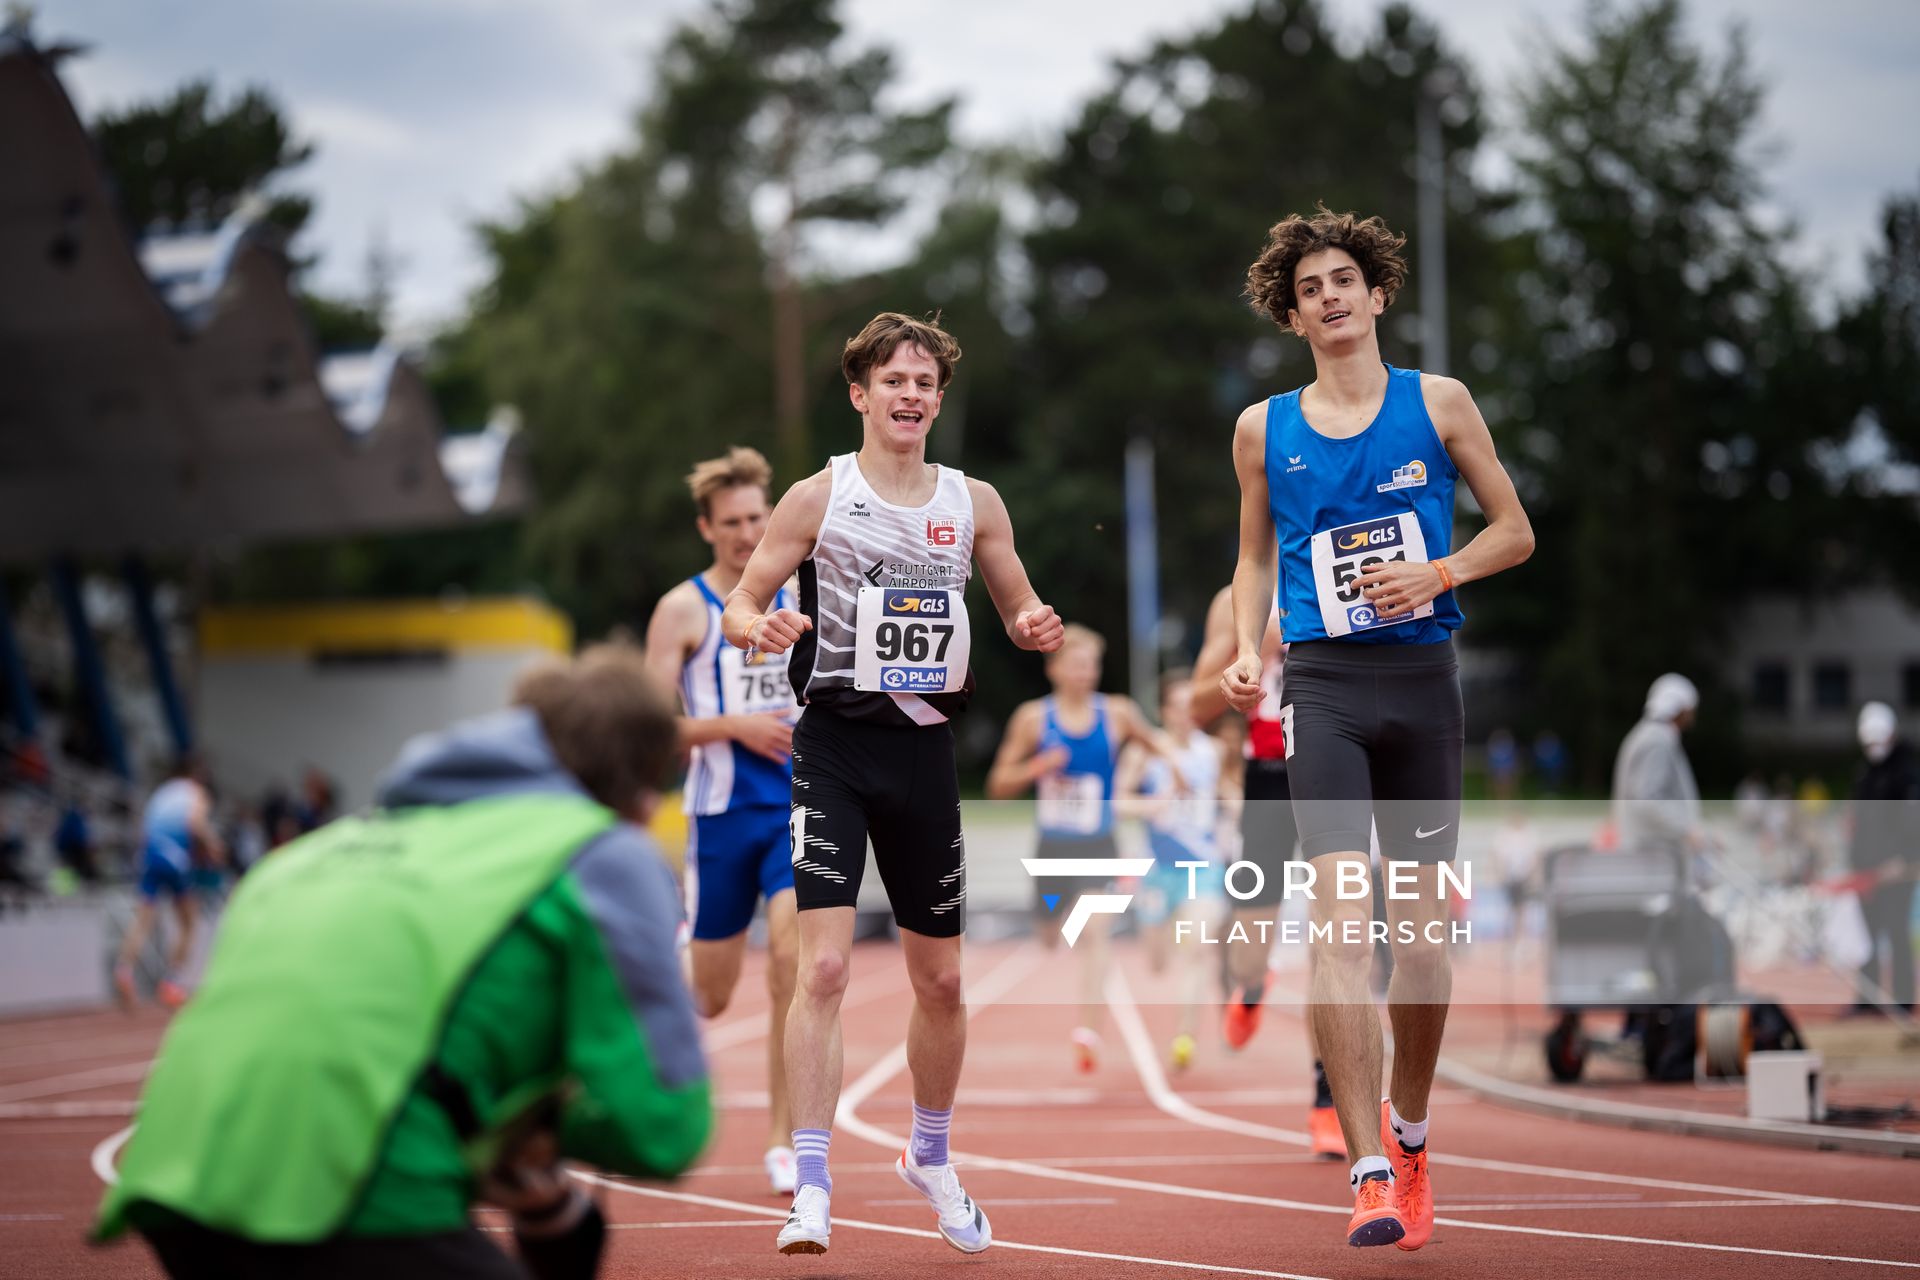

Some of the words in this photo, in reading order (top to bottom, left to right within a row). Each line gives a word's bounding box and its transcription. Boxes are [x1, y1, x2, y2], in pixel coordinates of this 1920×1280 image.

[1286, 464, 1306, 473] erima
[1369, 526, 1396, 545] GLS
[888, 578, 938, 590] AIRPORT
[919, 598, 945, 613] GLS
[875, 622, 954, 663] 967
[908, 671, 945, 683] PLAN
[740, 672, 791, 701] 765
